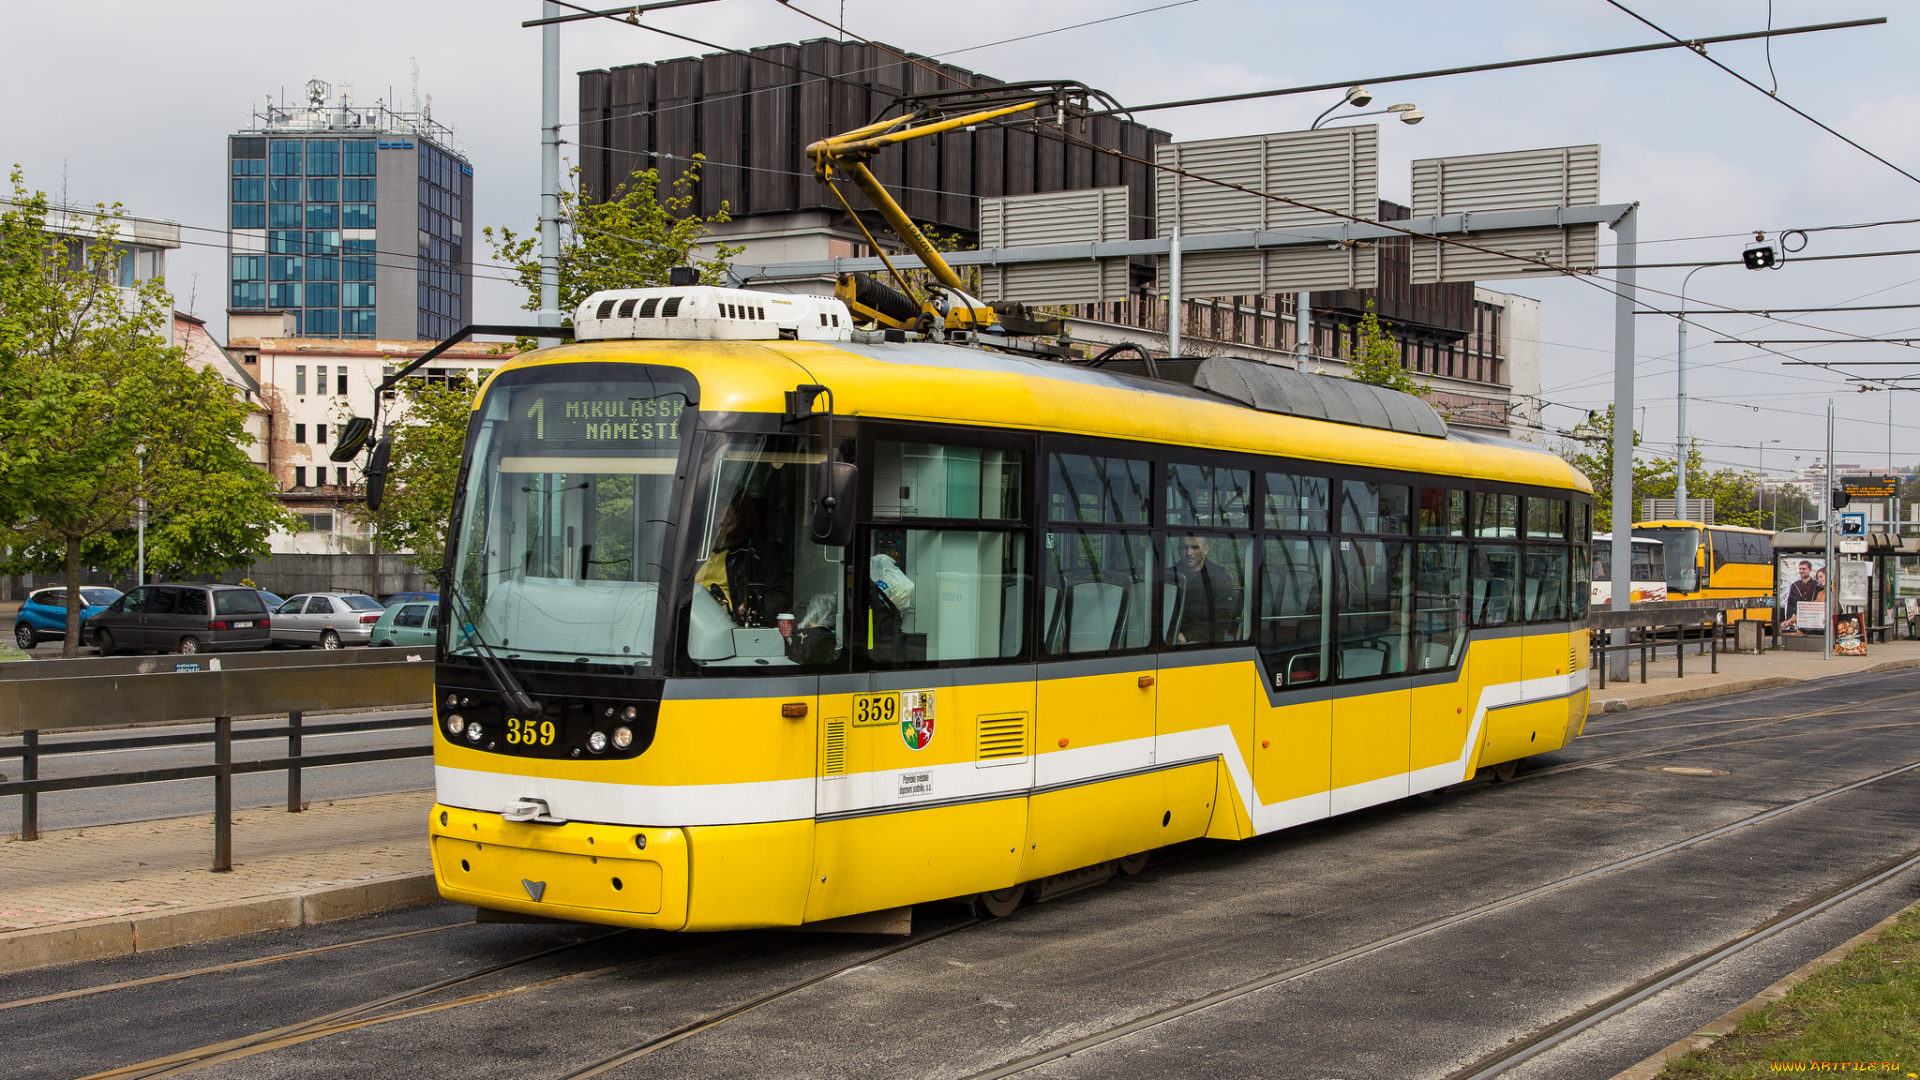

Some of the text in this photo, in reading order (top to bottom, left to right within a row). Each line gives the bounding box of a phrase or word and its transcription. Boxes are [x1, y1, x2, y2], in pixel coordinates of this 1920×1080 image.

[378, 138, 414, 149] bcb
[528, 398, 544, 439] 1
[858, 697, 895, 722] 359
[506, 718, 555, 746] 359
